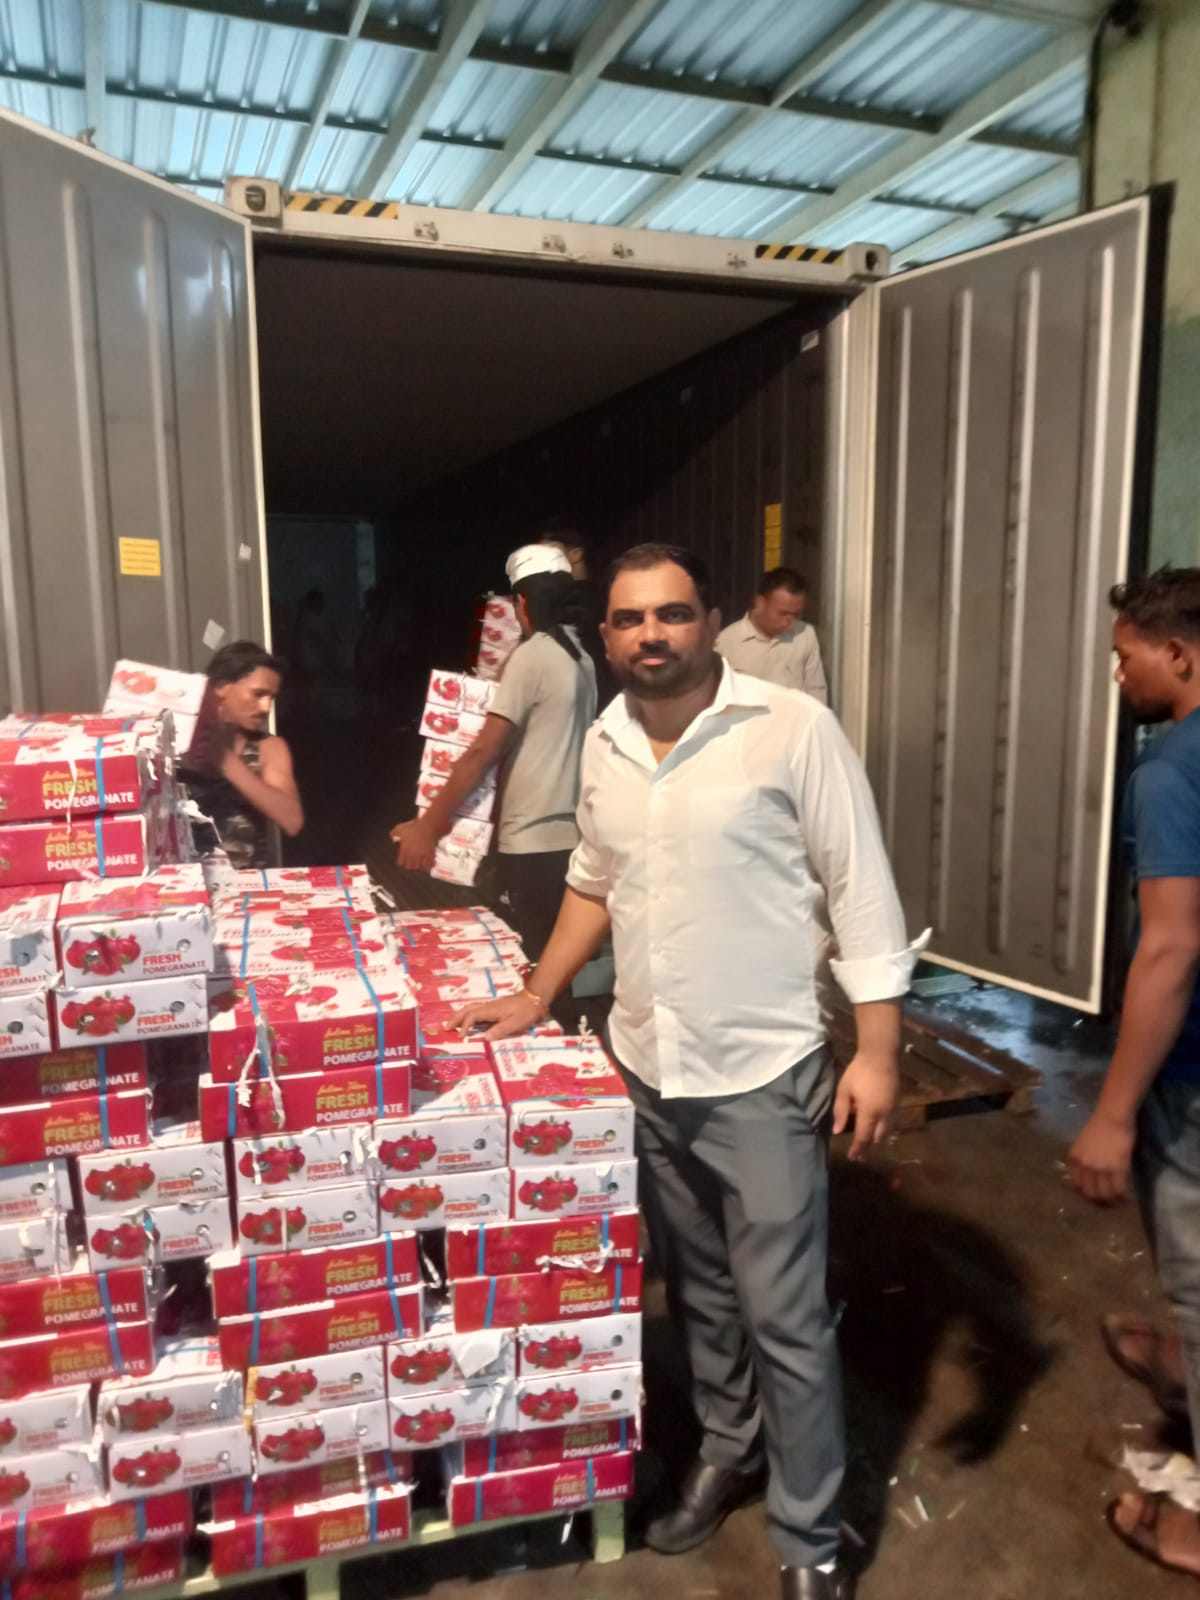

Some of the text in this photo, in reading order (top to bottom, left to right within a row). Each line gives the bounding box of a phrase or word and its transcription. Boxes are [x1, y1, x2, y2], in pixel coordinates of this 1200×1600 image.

[42, 779, 97, 796] FRESH
[44, 792, 135, 810] POMEGRNATE
[45, 841, 96, 858] FRESH
[47, 854, 137, 872] POMEGRNATE
[143, 953, 181, 965] FRESH
[143, 960, 206, 975] POMEGRANATE
[137, 1013, 176, 1026] FRESH
[137, 1019, 202, 1034] POMEGRANATE
[323, 1035, 376, 1053] FRESH
[41, 1072, 139, 1095] POMEGRNATE
[316, 1091, 369, 1110] FRESH
[44, 1121, 102, 1143] FRESH
[45, 1134, 141, 1156] POMEGRNATE
[438, 1153, 471, 1163] FRESH
[552, 1237, 600, 1253] FRESH
[326, 1264, 378, 1284] FRESH
[560, 1285, 609, 1302] FRESH
[328, 1319, 380, 1341] FRESH
[53, 1359, 145, 1384] POMEGRAATE
